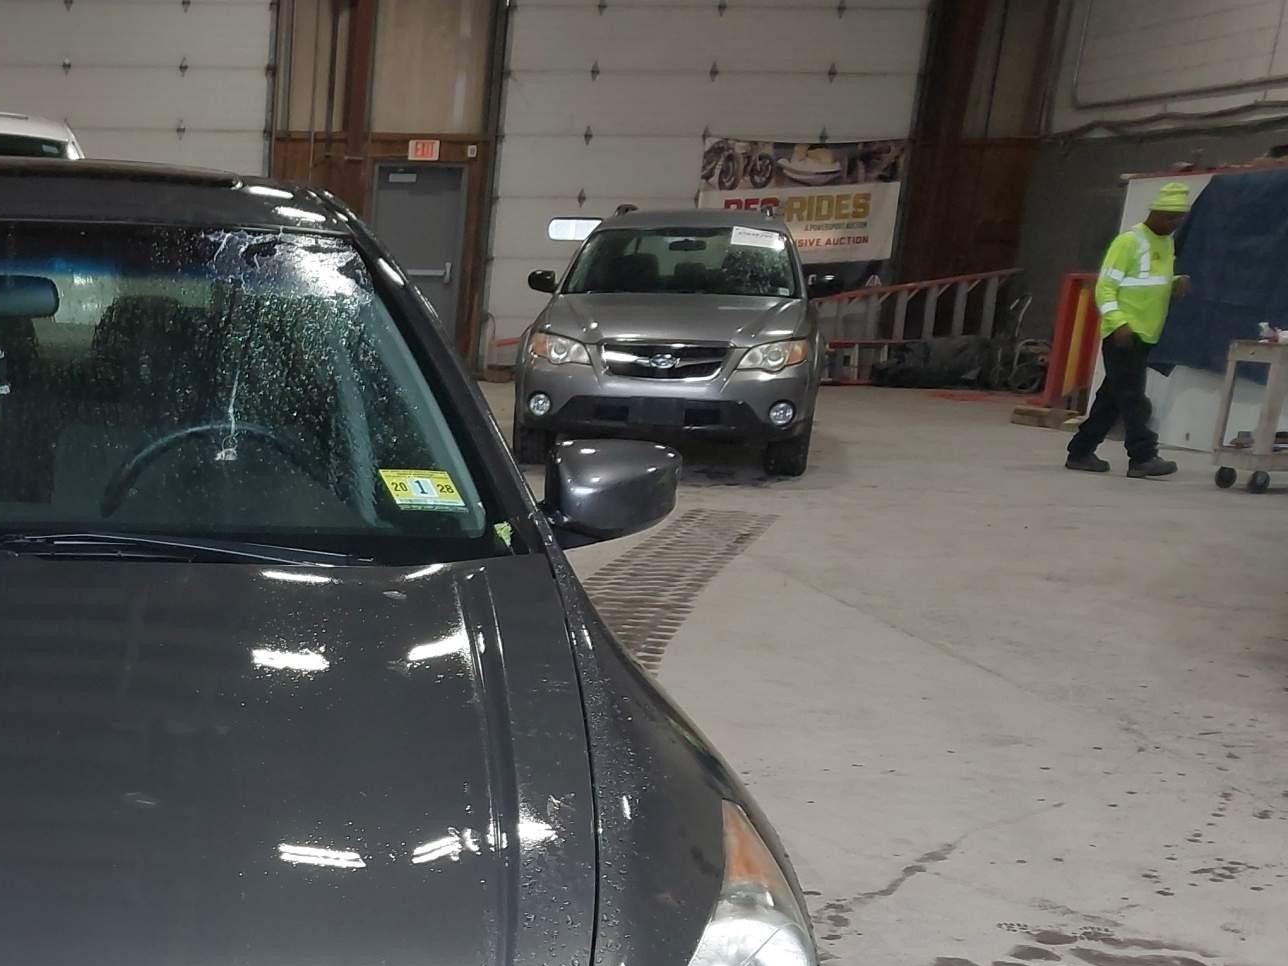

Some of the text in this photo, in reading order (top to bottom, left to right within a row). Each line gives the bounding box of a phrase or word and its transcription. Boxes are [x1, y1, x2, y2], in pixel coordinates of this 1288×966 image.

[785, 193, 872, 222] RIDES
[825, 235, 869, 246] AUCTION
[391, 480, 455, 495] 20 1 28
